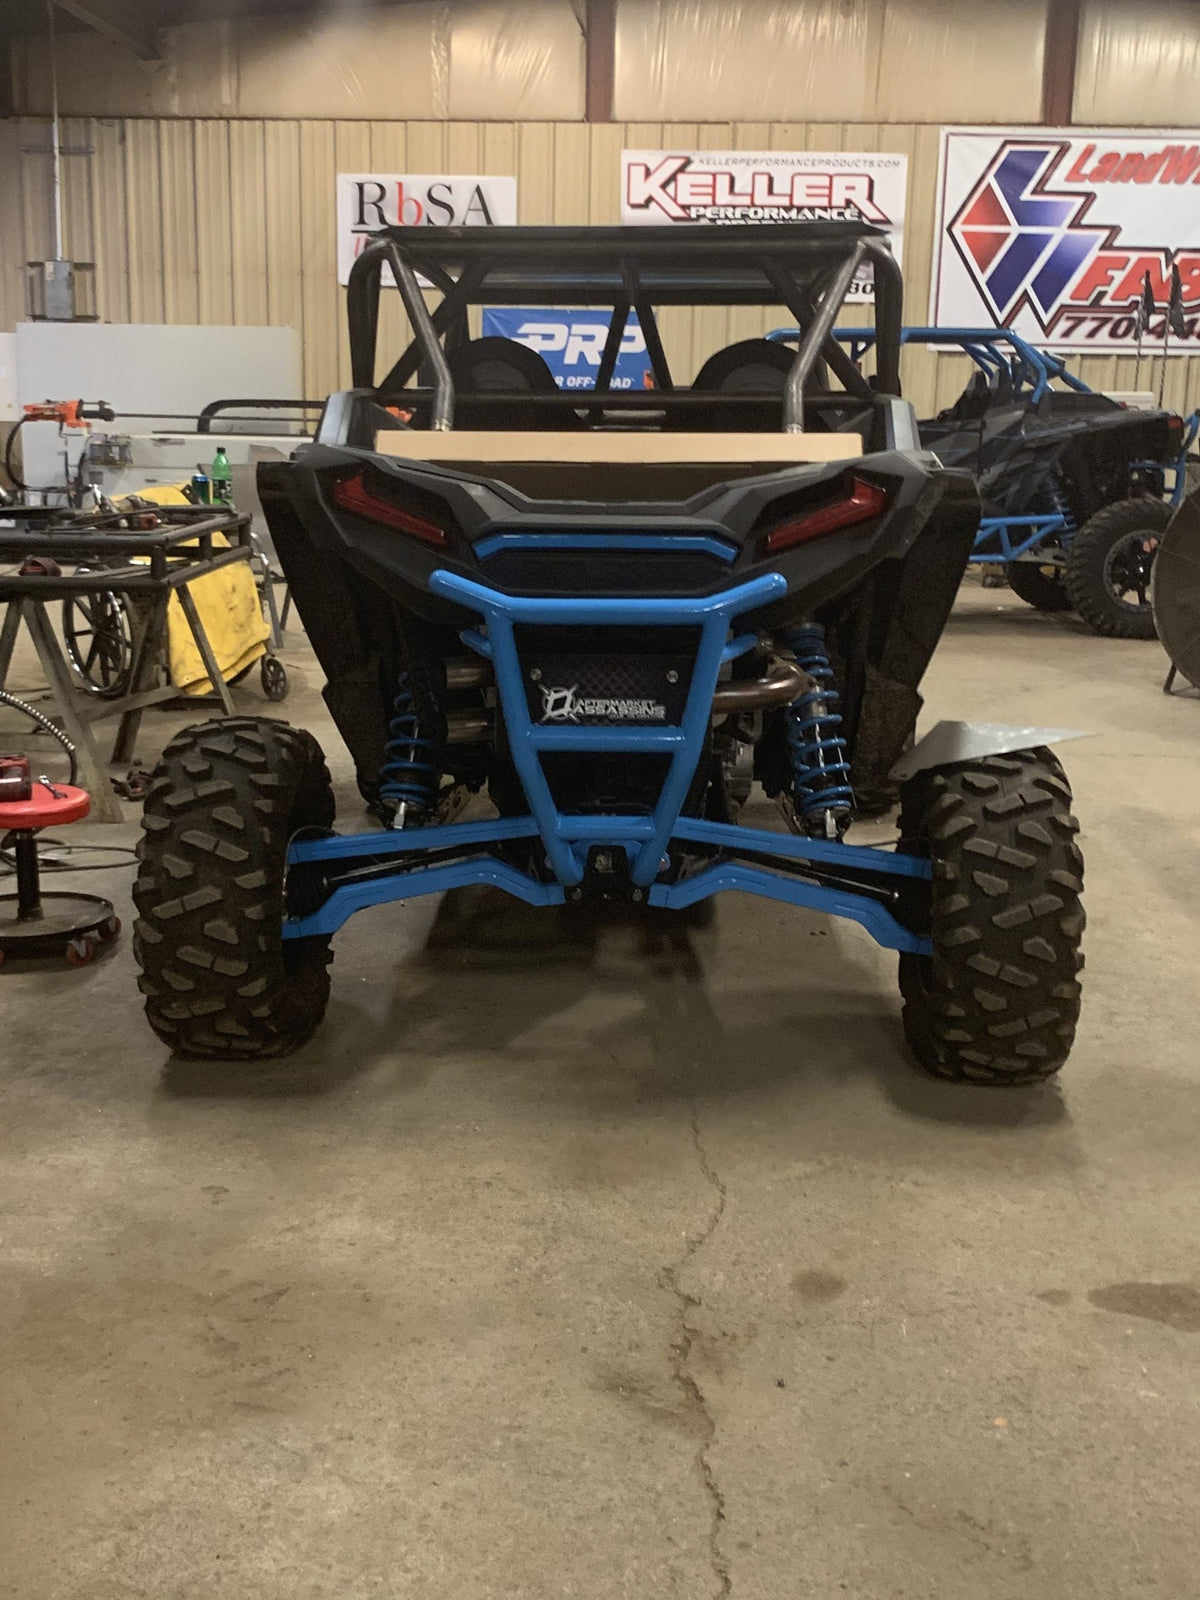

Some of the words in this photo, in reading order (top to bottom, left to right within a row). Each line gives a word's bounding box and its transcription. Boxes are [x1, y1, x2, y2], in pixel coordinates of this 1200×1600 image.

[699, 158, 901, 169] KELLERPERFORMANCEPRODUCTS.COM
[1064, 144, 1200, 184] LandW
[352, 181, 494, 225] RbSA
[627, 156, 892, 224] KELLER
[690, 206, 860, 221] PERFORMANCE
